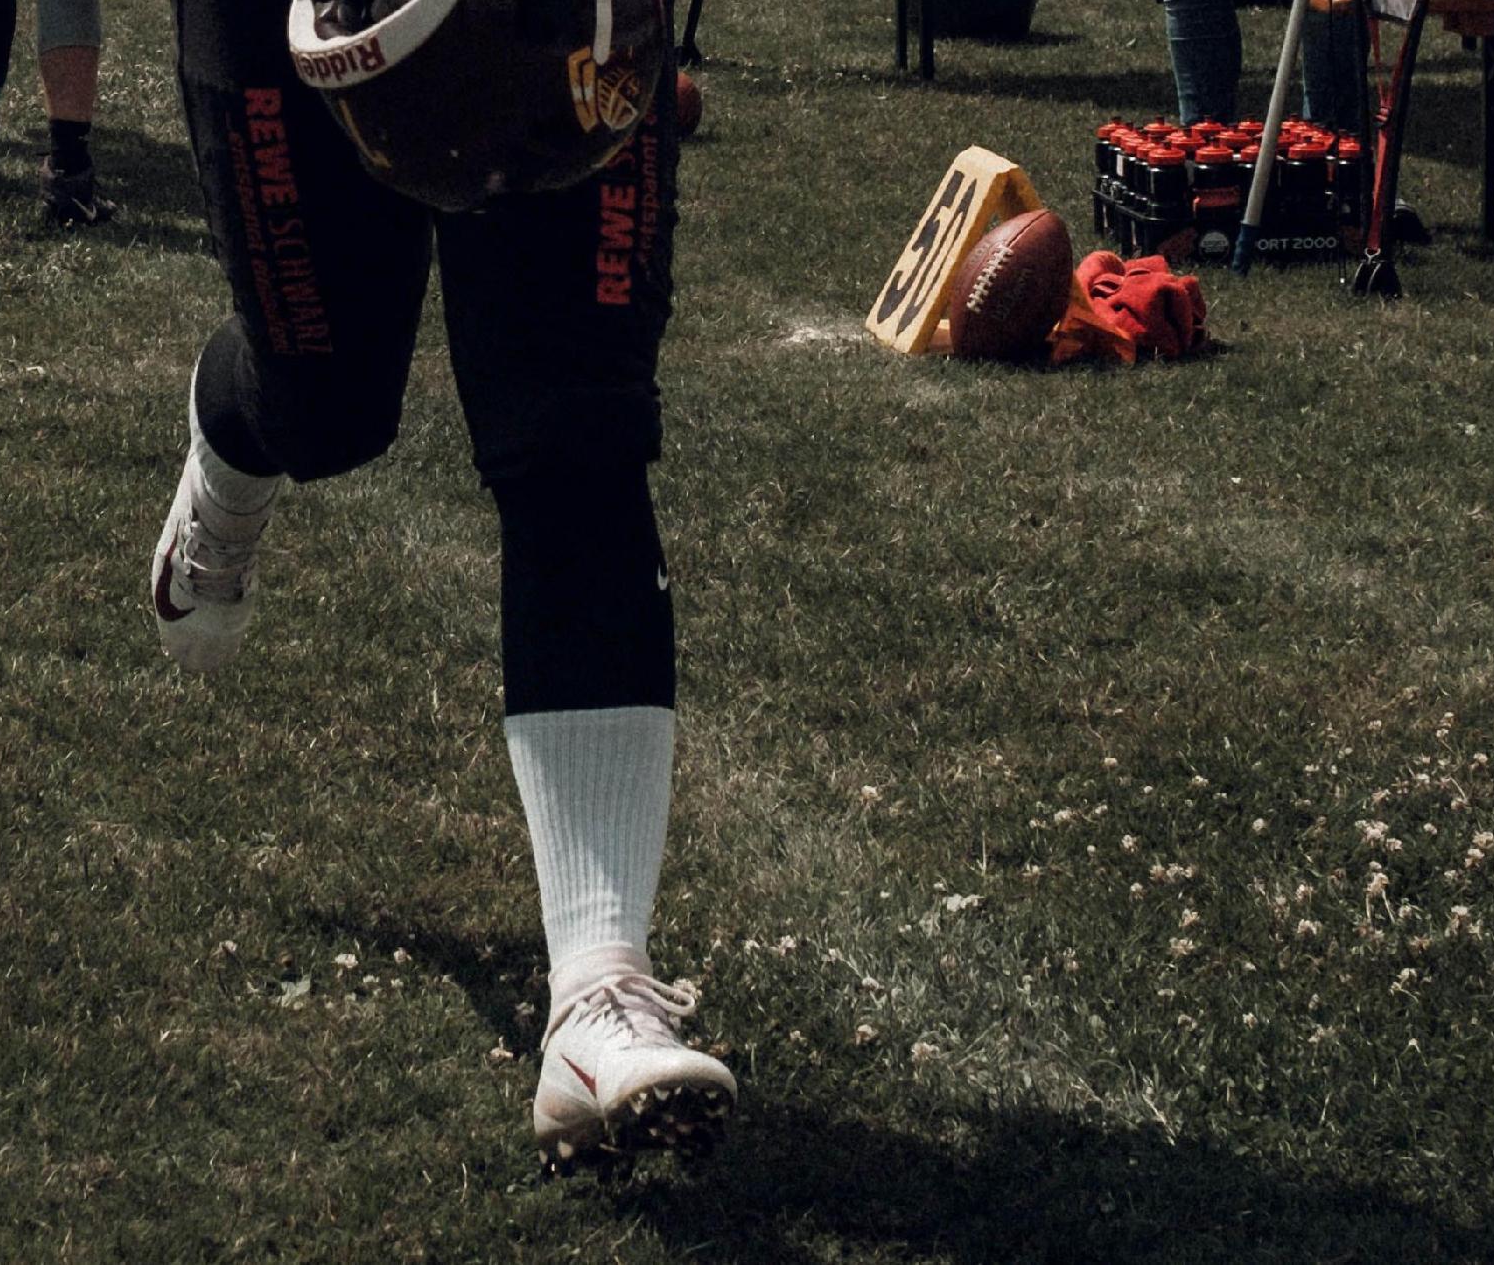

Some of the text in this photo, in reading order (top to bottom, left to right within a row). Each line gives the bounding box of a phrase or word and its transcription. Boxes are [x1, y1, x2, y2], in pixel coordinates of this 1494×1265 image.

[243, 86, 334, 355] REWE SCHWARZ
[596, 183, 636, 306] REWE
[876, 169, 978, 338] 50
[1291, 236, 1338, 250] 2000
